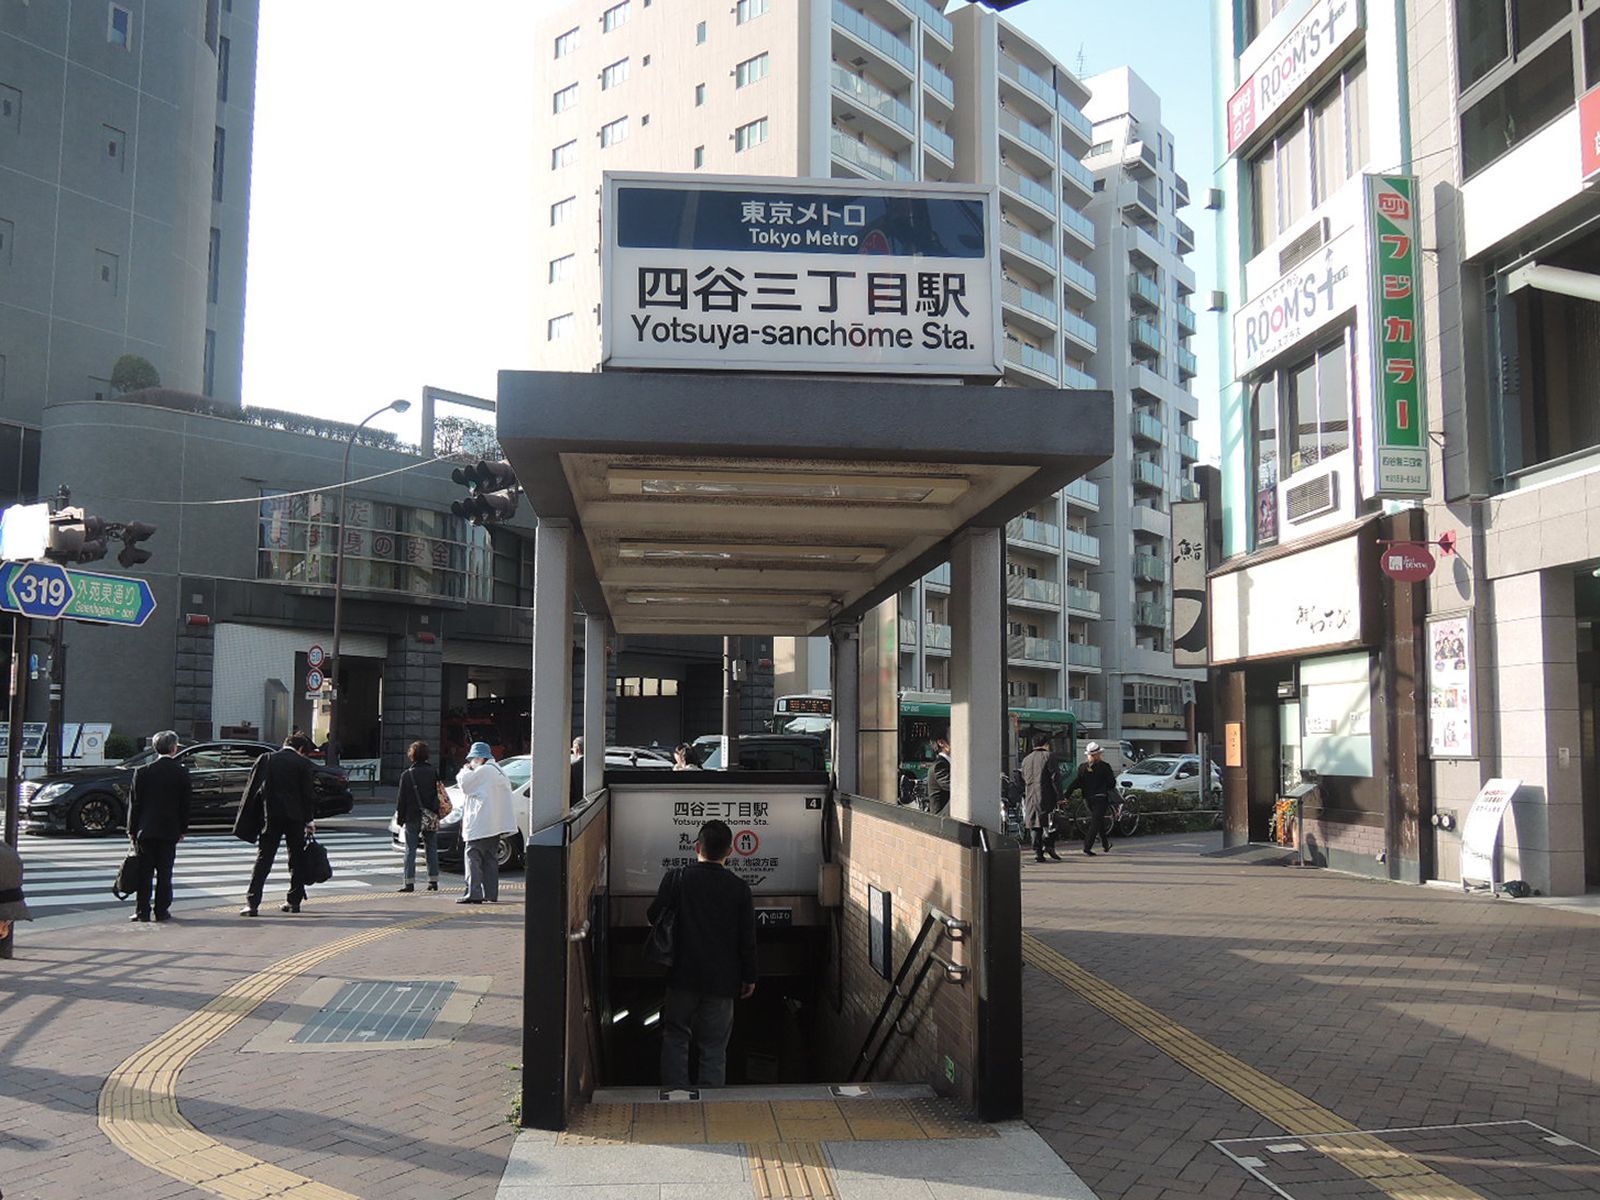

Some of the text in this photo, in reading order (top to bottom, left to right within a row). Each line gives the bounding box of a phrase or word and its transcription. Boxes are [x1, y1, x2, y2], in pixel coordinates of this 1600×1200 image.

[741, 200, 866, 227] 東京メトロ
[749, 227, 859, 247] Tokyo Metro
[637, 265, 970, 318] 四谷三丁目駅
[922, 321, 975, 350] Sta.
[1382, 235, 1415, 429] フジカラー
[20, 575, 66, 606] 319
[674, 802, 768, 818] 四谷三丁目駅
[809, 799, 817, 808] 4
[754, 818, 769, 826] Sta.
[741, 842, 752, 850] 11
